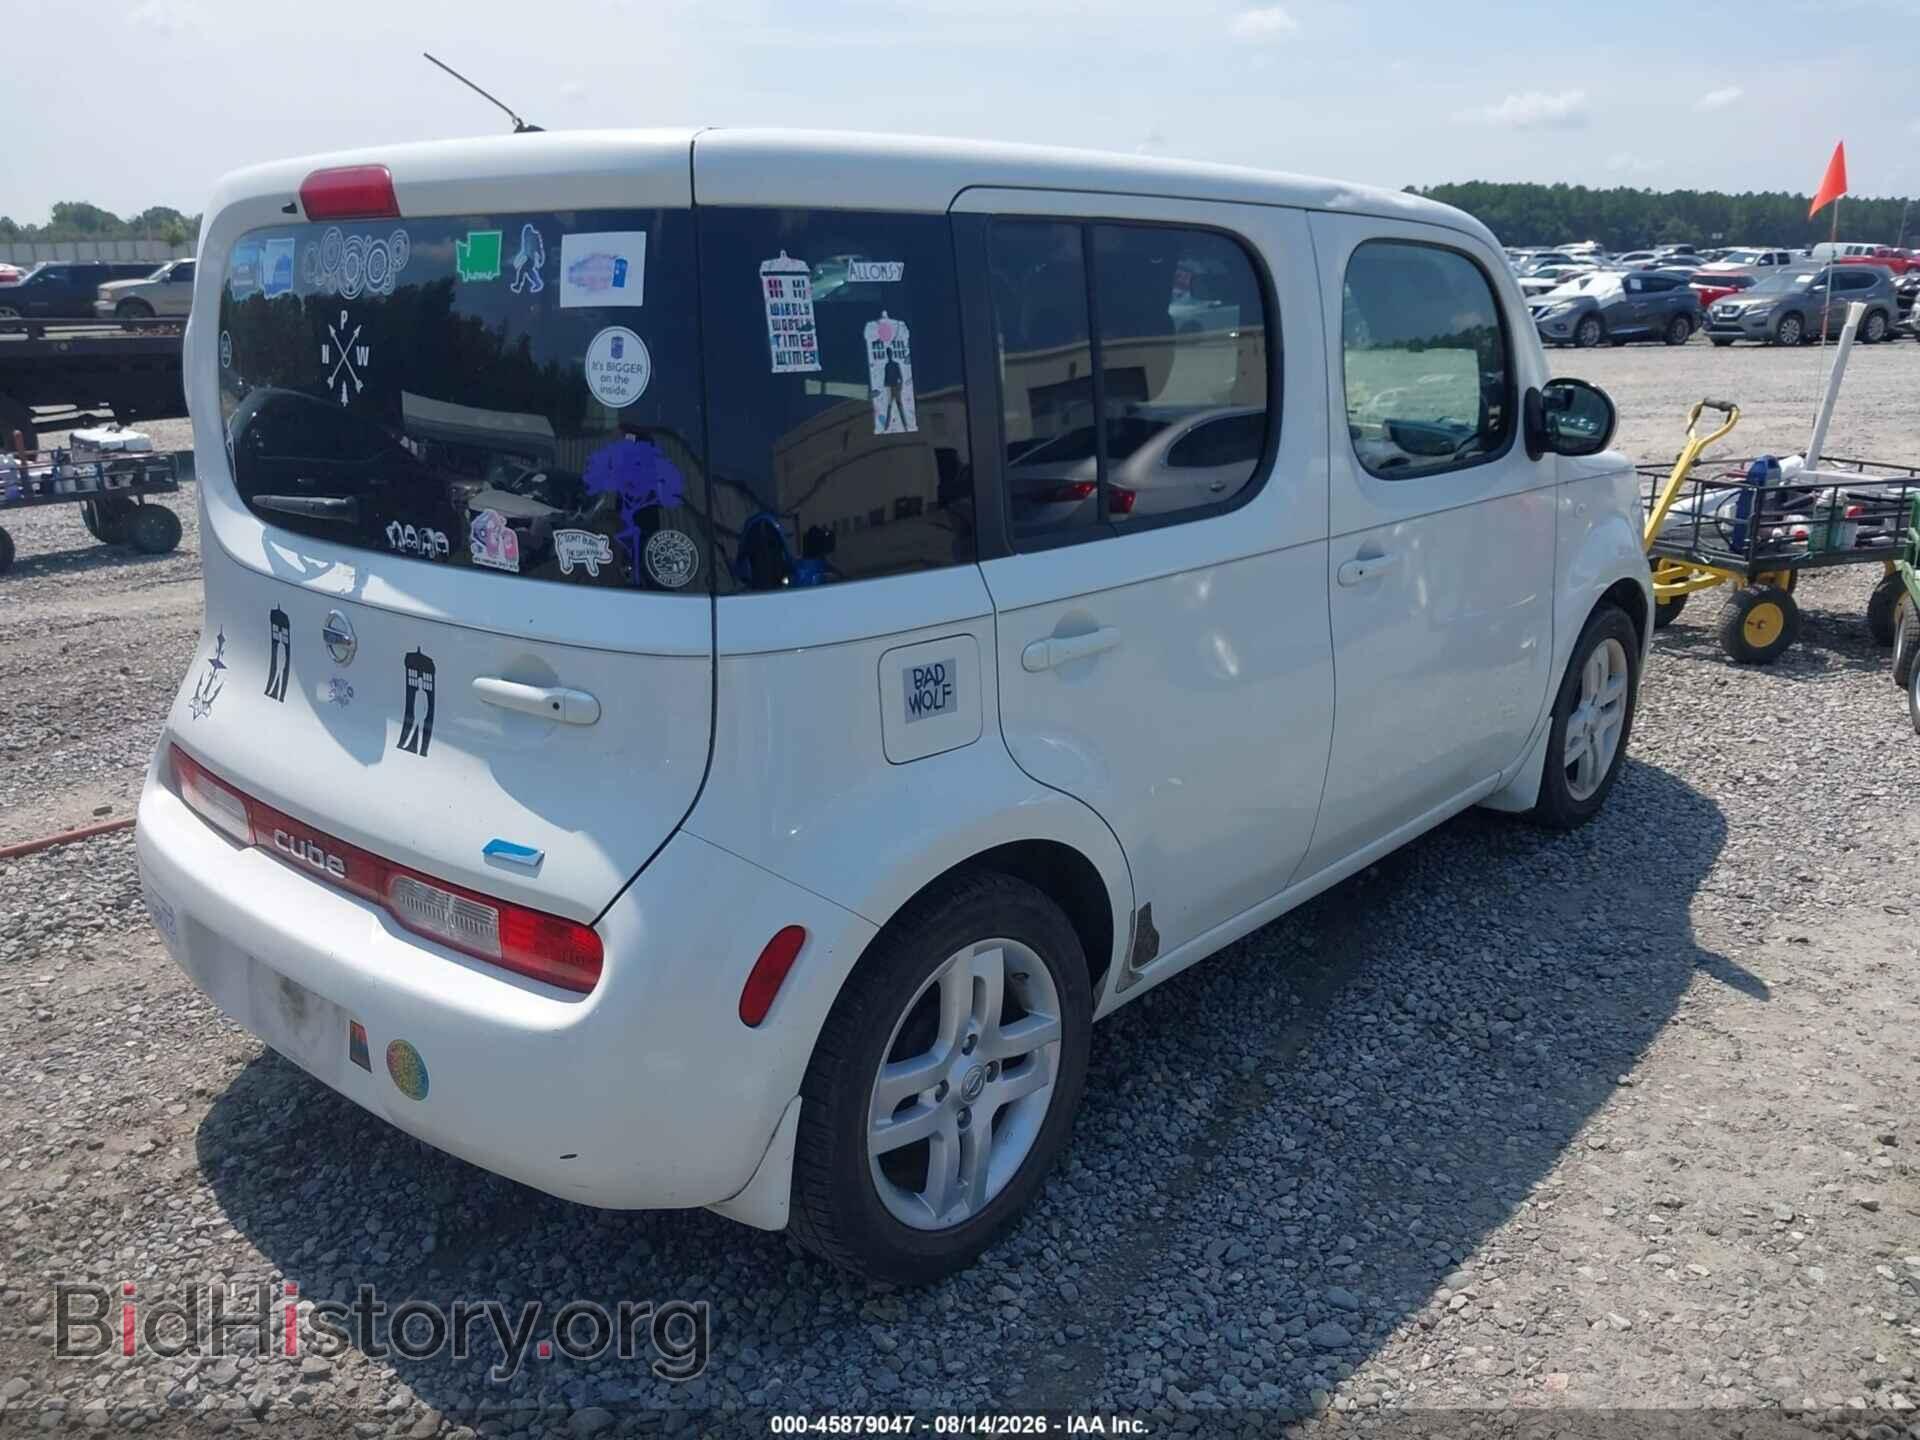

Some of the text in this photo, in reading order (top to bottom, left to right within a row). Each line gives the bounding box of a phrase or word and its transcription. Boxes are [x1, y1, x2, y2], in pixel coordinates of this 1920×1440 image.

[341, 309, 348, 331] P
[356, 345, 370, 367] W
[606, 361, 643, 375] BIGGER
[912, 663, 946, 690] BAD
[908, 683, 952, 716] WOLF
[274, 828, 345, 879] cube
